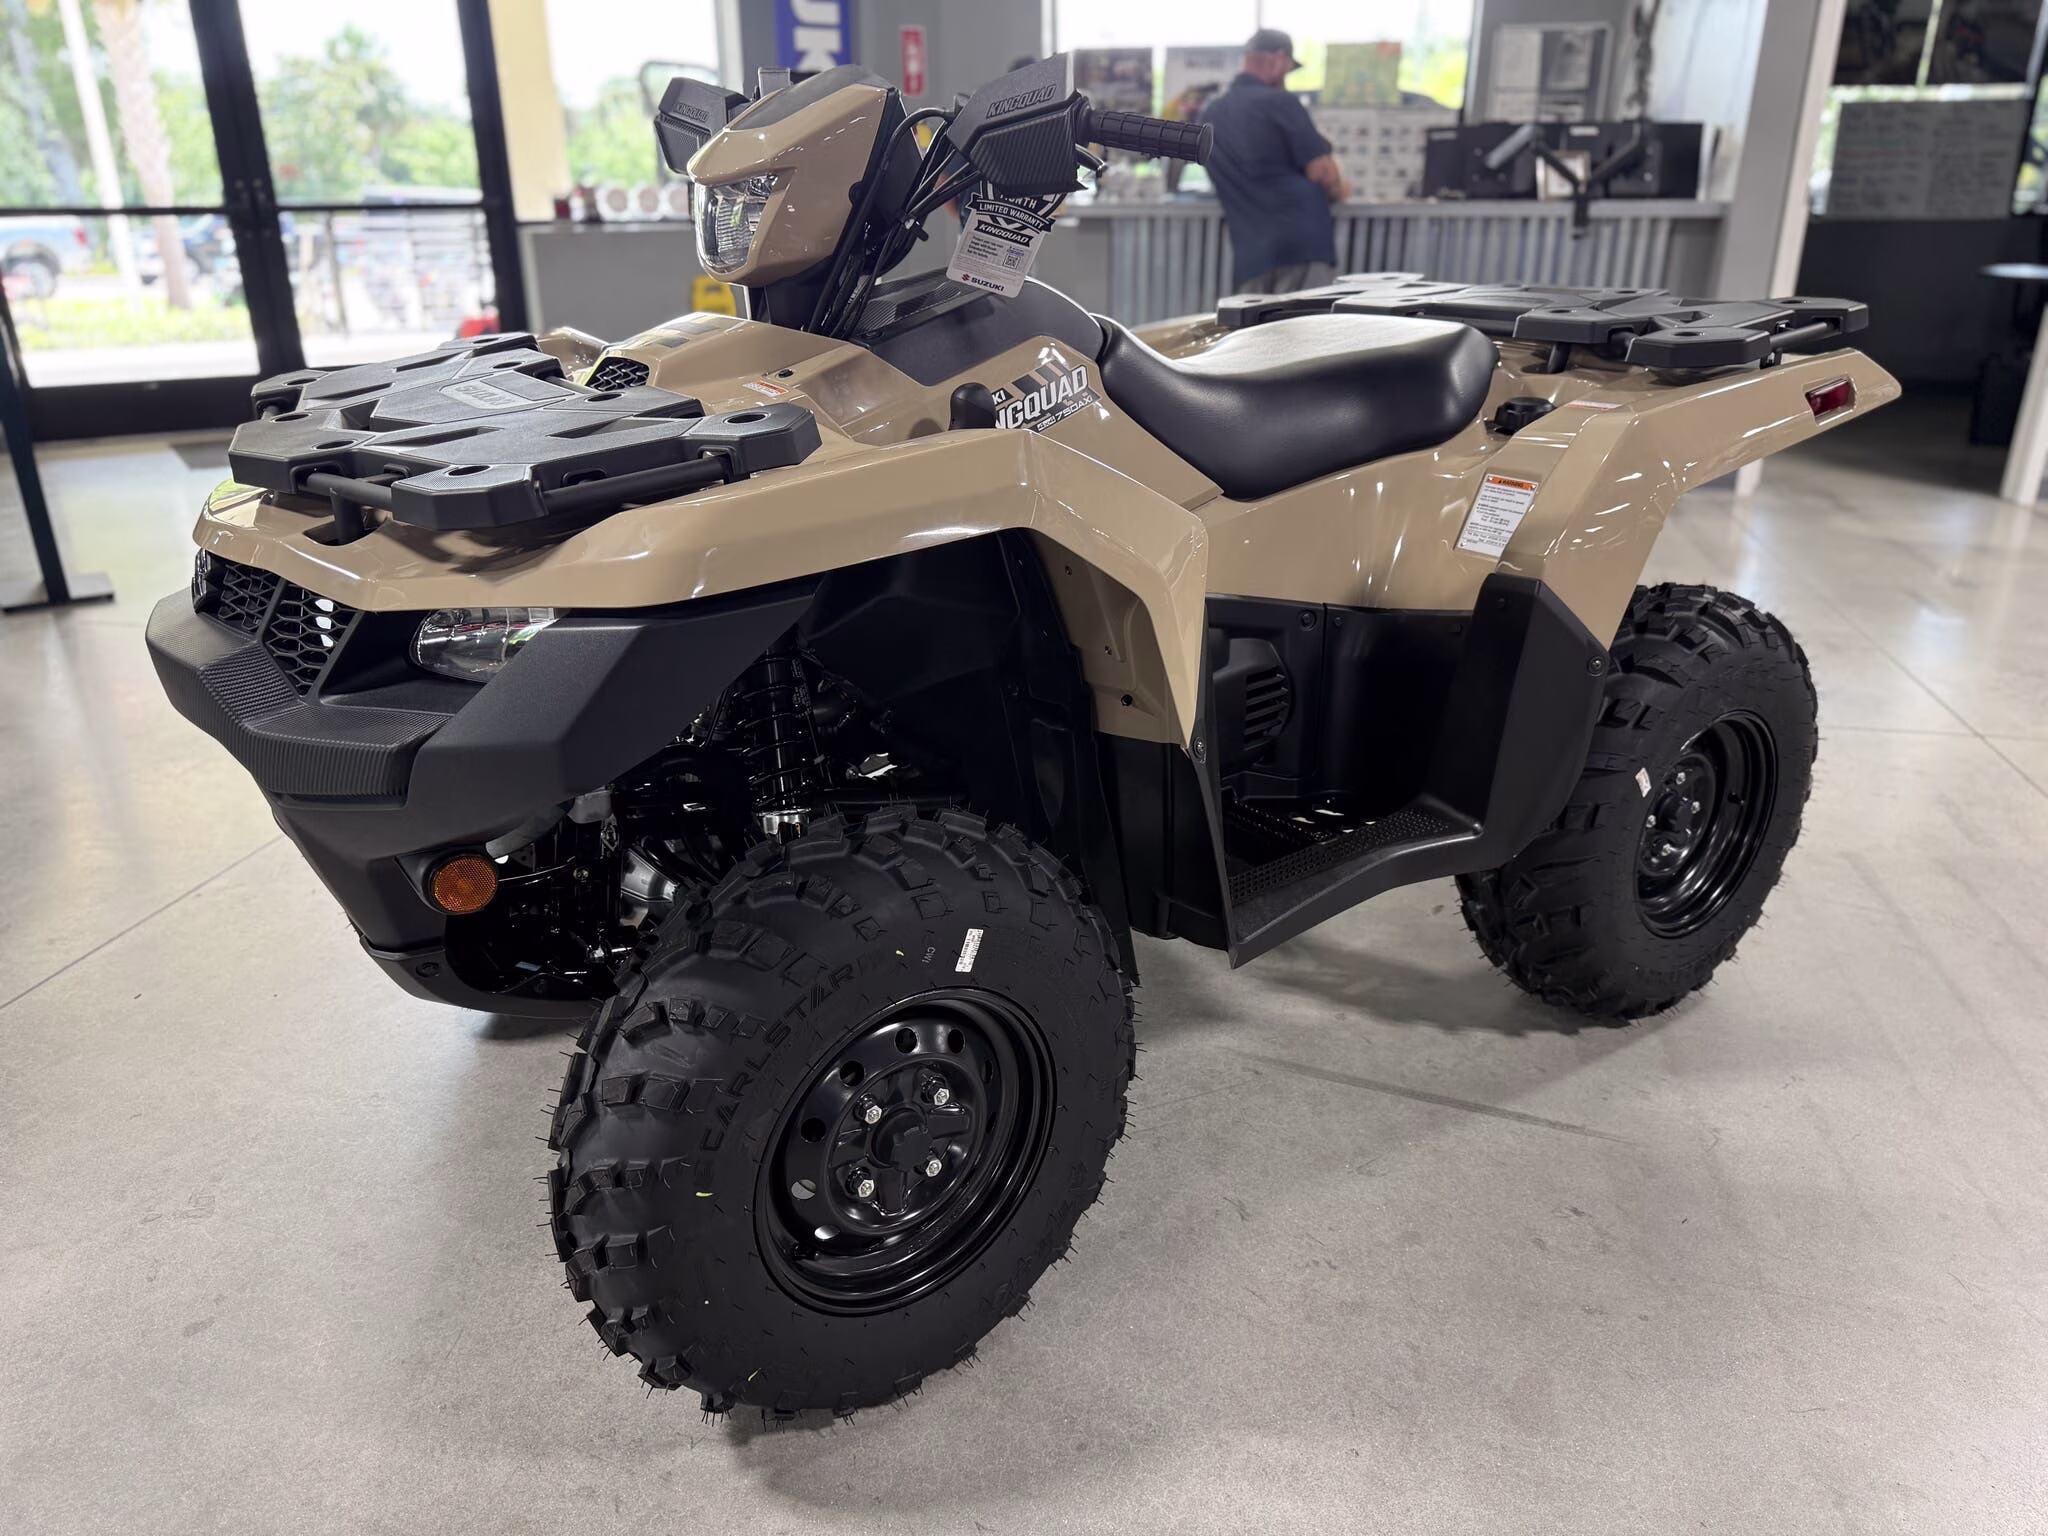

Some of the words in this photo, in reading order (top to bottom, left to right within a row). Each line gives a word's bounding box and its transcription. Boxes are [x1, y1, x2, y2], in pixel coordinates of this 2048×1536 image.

[985, 84, 1057, 119] KINGQUAD
[979, 203, 1009, 214] LIMITED
[1010, 208, 1045, 229] WARRANTY
[979, 223, 1030, 244] KINGQUAD
[971, 277, 1005, 292] SUZUKI
[702, 964, 857, 1151] CARLSTAR
